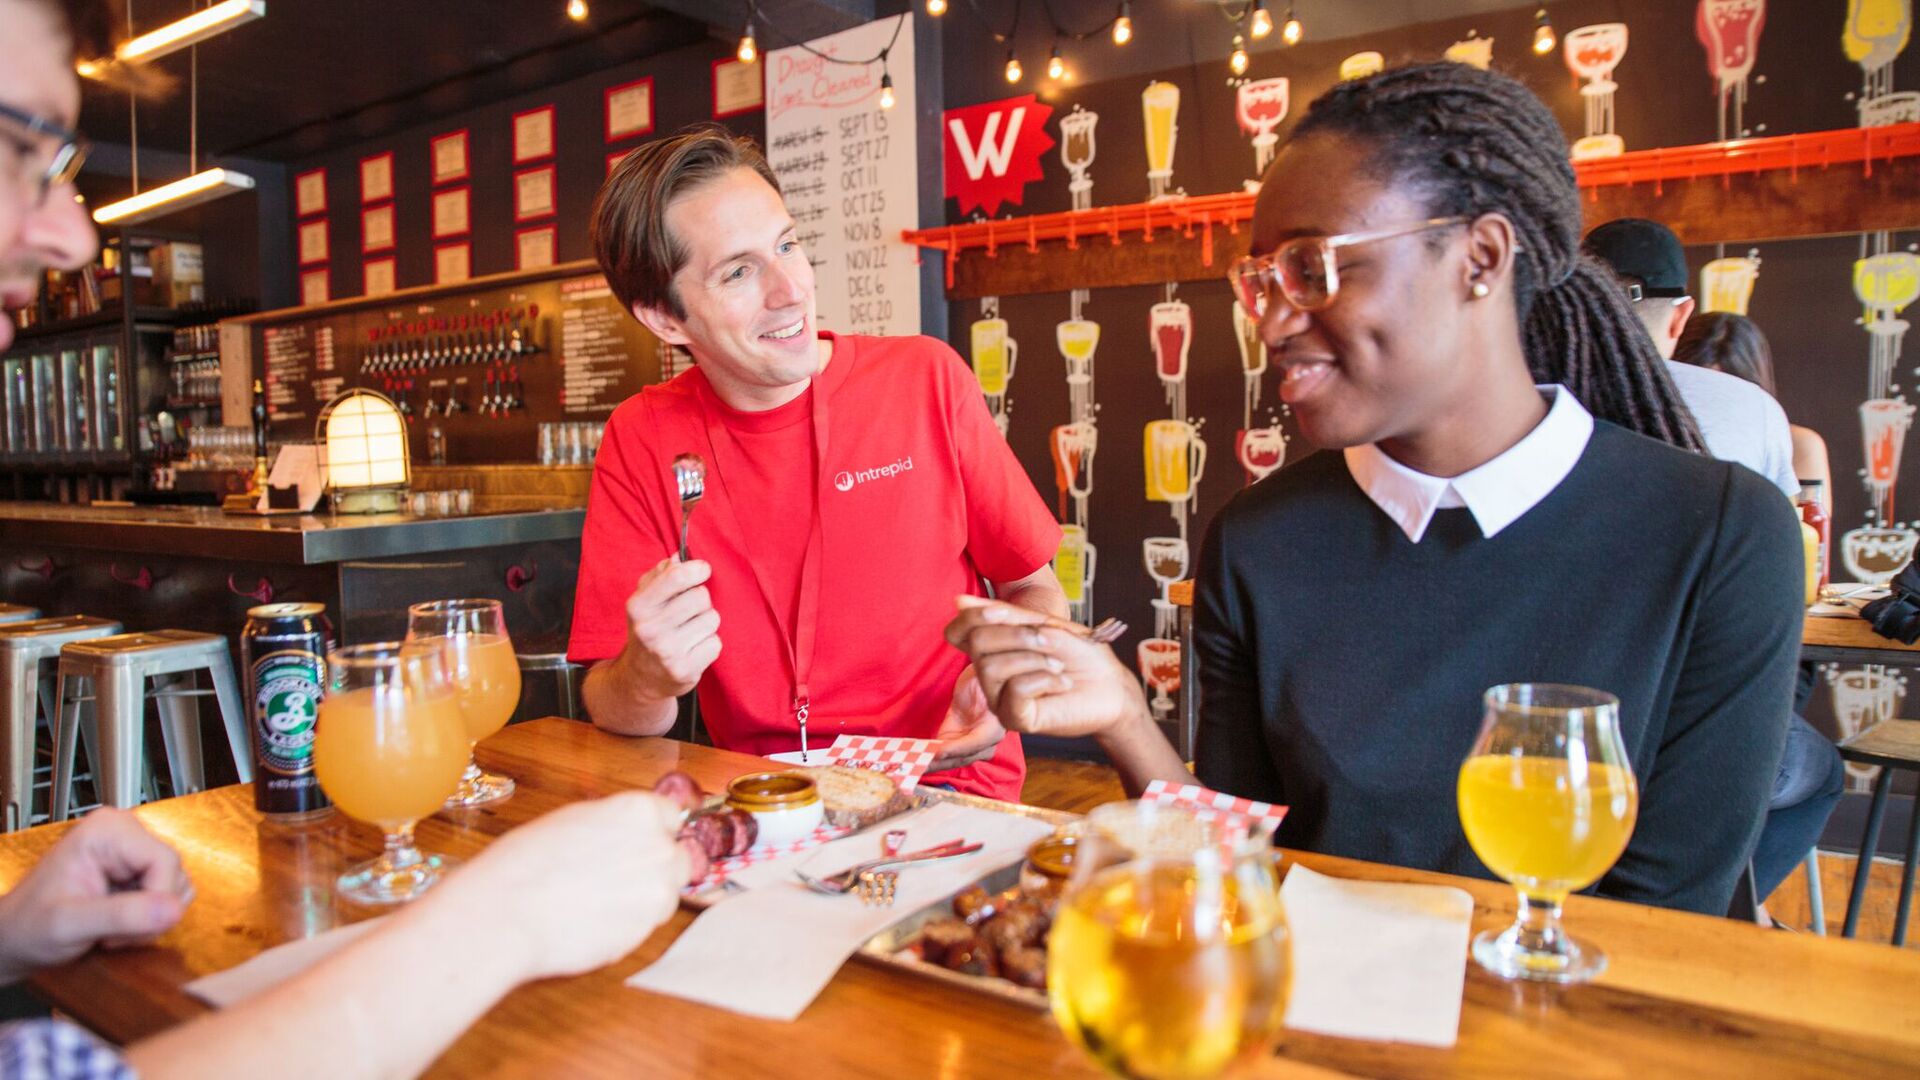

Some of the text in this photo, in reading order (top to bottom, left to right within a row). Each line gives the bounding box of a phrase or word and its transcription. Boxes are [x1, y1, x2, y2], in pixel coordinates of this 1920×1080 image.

[839, 109, 888, 138] SEPT 13
[841, 135, 890, 167] SEPT 27
[948, 106, 1027, 181] W
[841, 165, 879, 191] OCT 11
[842, 190, 887, 218] OCT 25
[844, 217, 882, 242] NOV 8
[846, 248, 873, 271] NOV
[873, 245, 887, 269] 22
[848, 274, 885, 298] DEC 6
[850, 300, 892, 324] DEC 20
[855, 456, 914, 484] Intrepid
